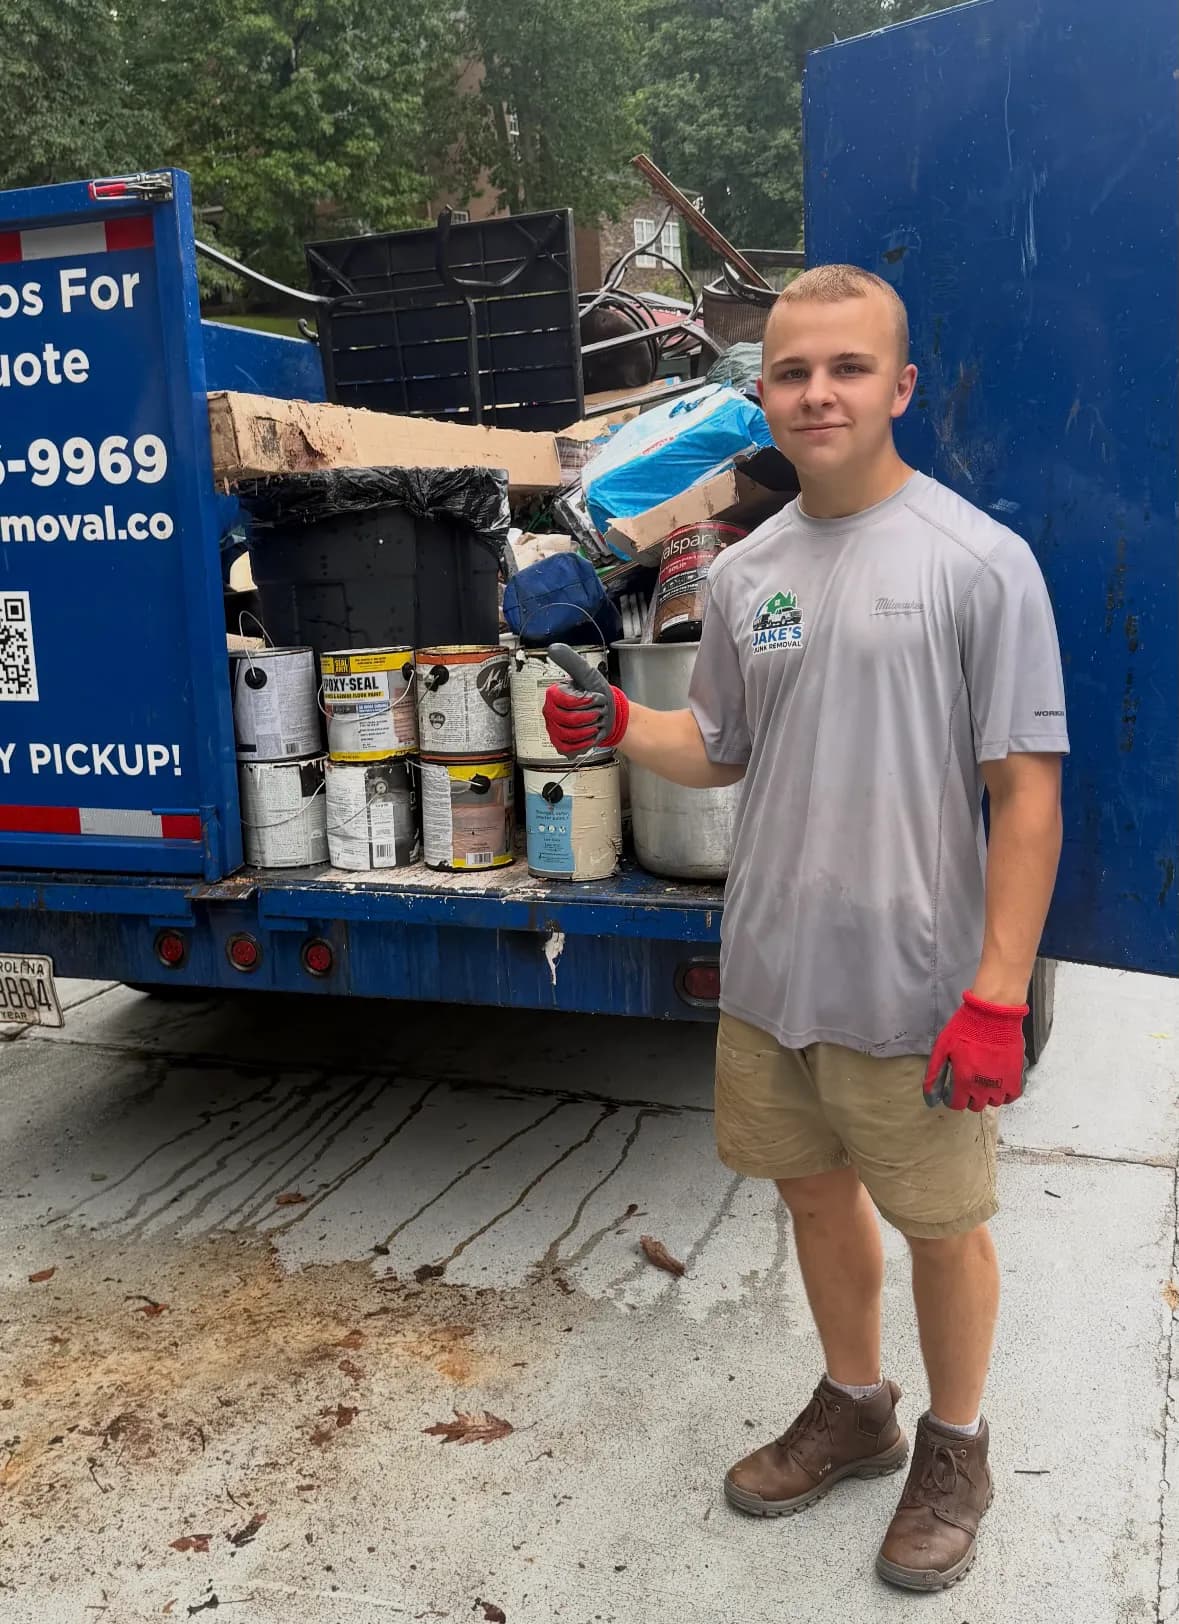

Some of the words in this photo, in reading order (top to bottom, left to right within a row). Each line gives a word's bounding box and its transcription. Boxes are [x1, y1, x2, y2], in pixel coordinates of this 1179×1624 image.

[60, 268, 140, 313] For
[0, 434, 168, 487] -9969
[1, 505, 174, 542] moval.co
[661, 533, 712, 561] alspar
[752, 626, 802, 646] JAKE'S
[768, 640, 802, 649] REMOVAL
[29, 743, 182, 776] PICKUP!
